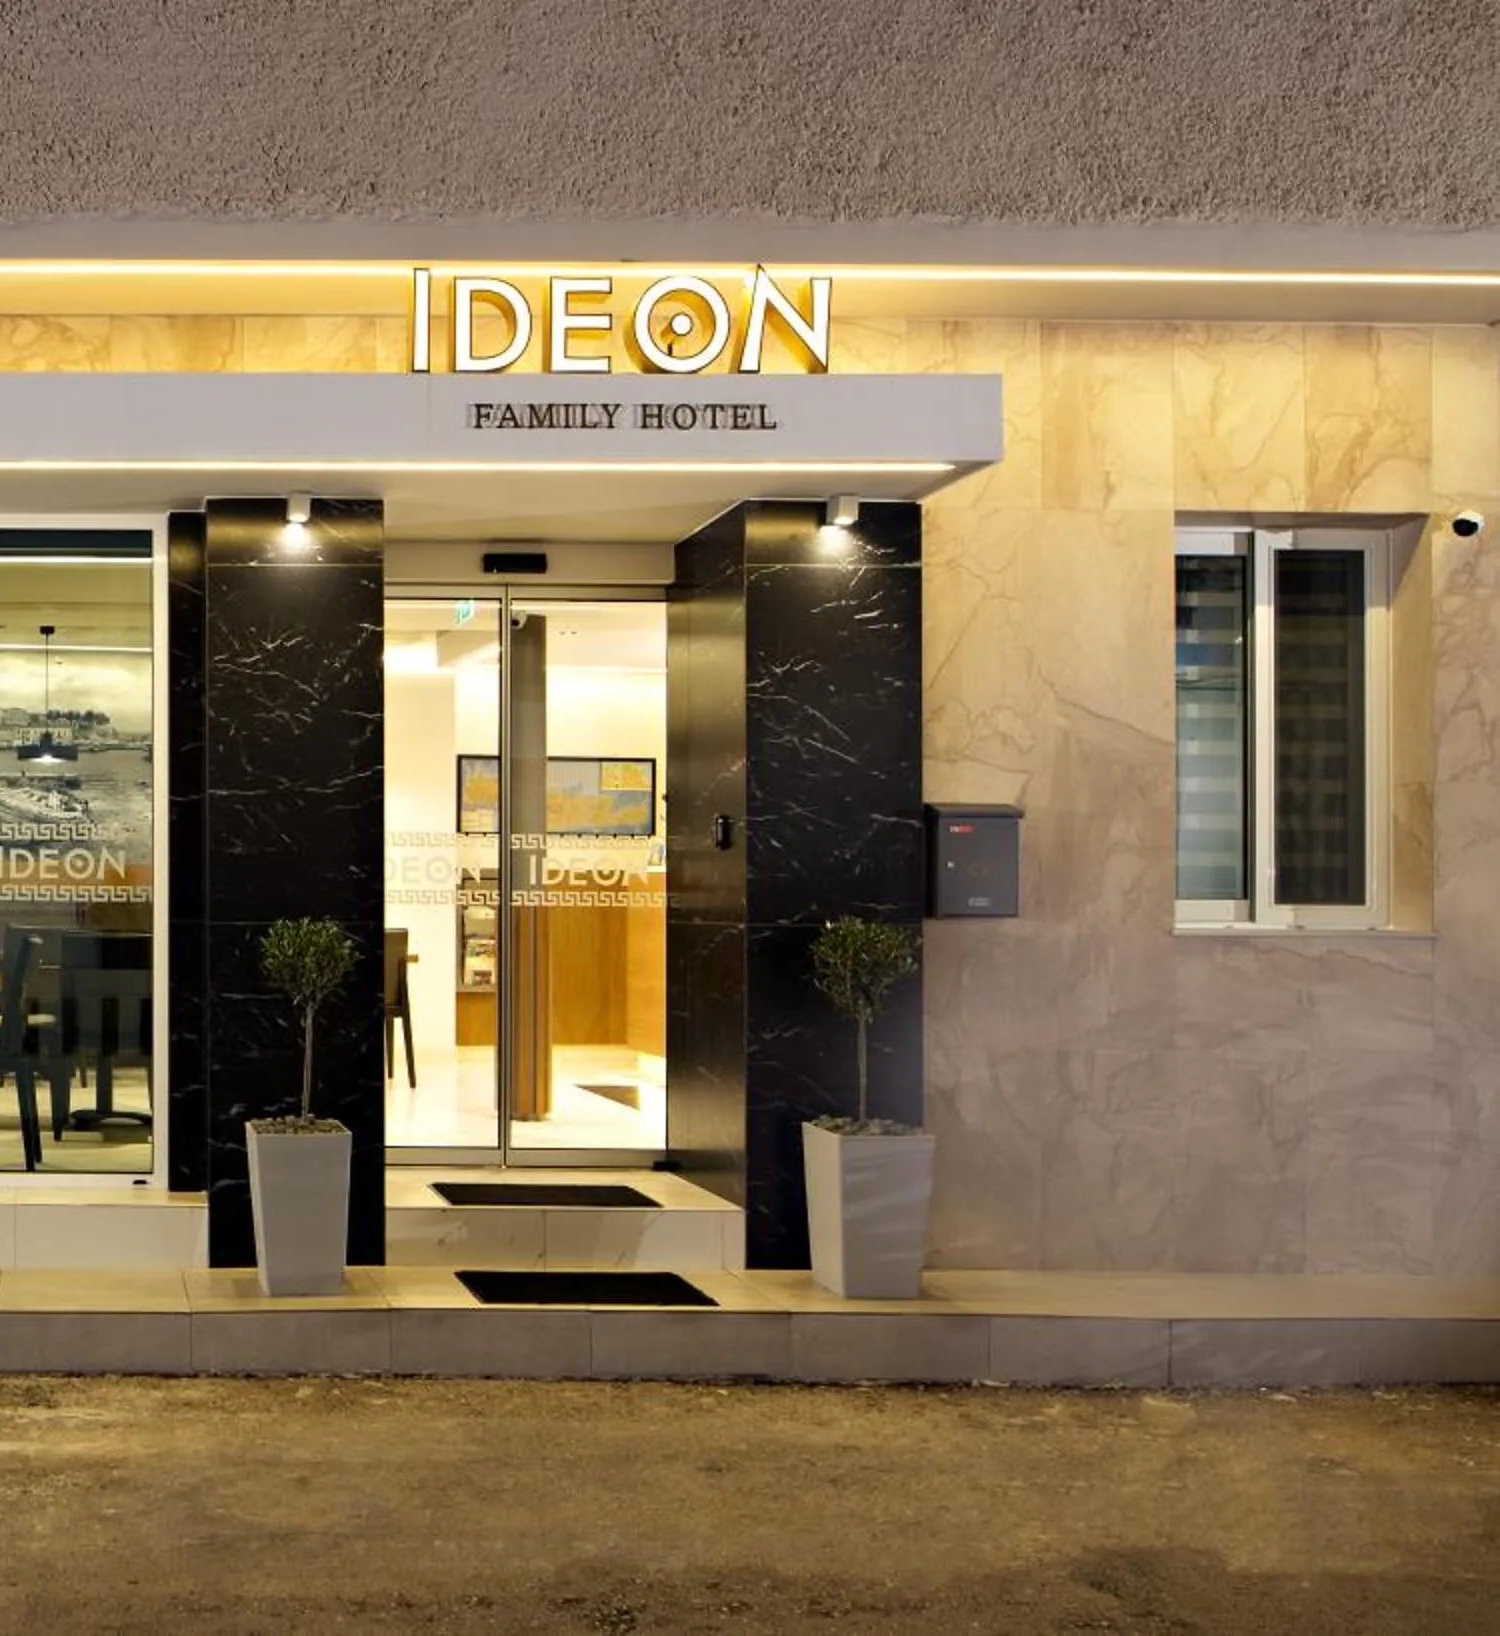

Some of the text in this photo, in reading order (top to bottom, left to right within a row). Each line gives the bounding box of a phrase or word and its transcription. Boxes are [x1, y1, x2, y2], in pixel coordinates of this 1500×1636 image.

[411, 263, 833, 374] IDEON
[473, 402, 778, 430] FAMILY HOTEL
[384, 856, 481, 885] DEON
[529, 854, 650, 887] IDEON
